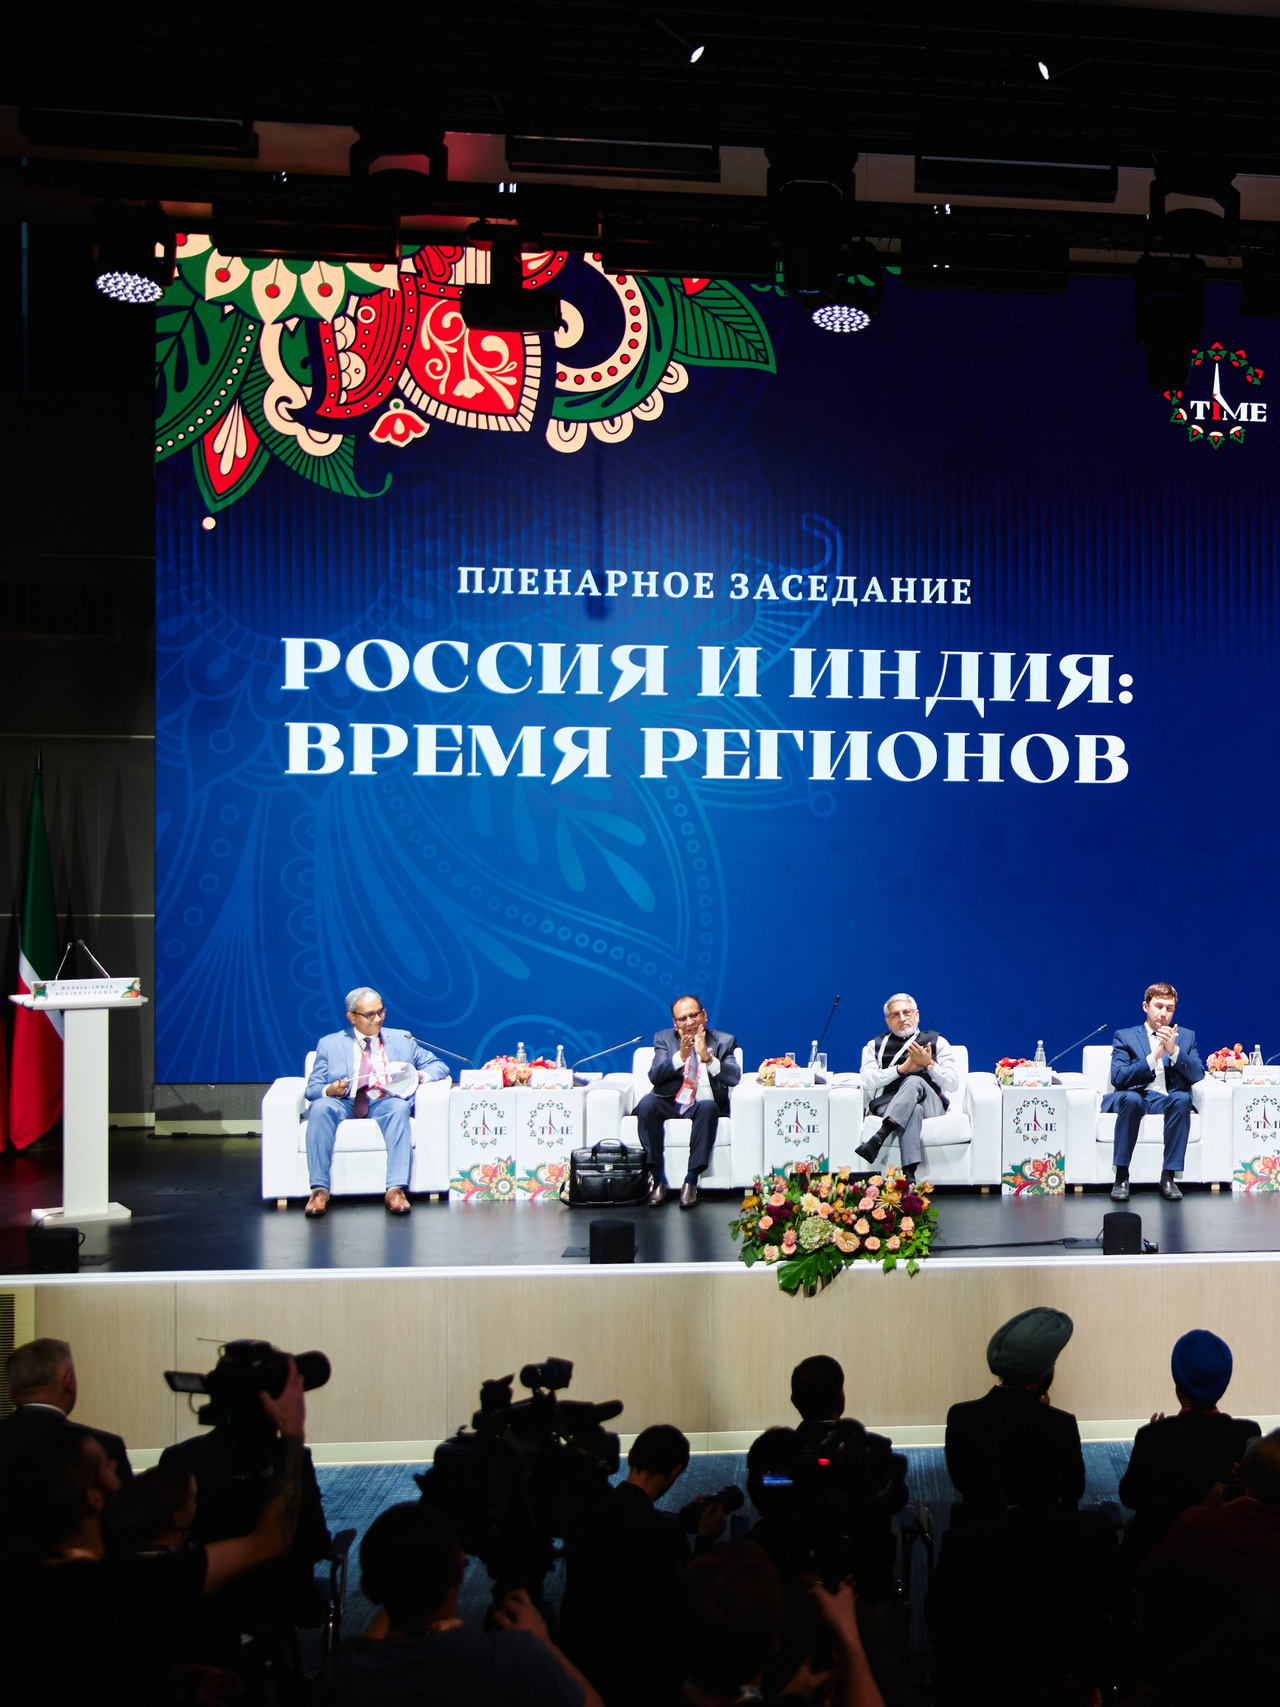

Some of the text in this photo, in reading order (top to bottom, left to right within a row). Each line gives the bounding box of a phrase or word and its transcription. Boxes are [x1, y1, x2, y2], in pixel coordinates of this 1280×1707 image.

[1190, 400, 1267, 422] TIME
[457, 566, 972, 608] ПЛЕНАРНОЕ ЗАСЕДАНИЕ
[280, 637, 1134, 719] РОССИЯ И ИНДИЯ:
[284, 722, 1130, 785] ВРЕМЯ РЕГИОНОВ
[472, 1126, 507, 1135] TIME
[539, 1126, 573, 1135] TIME
[786, 1124, 820, 1133] TIME
[1024, 1122, 1057, 1132] TIME
